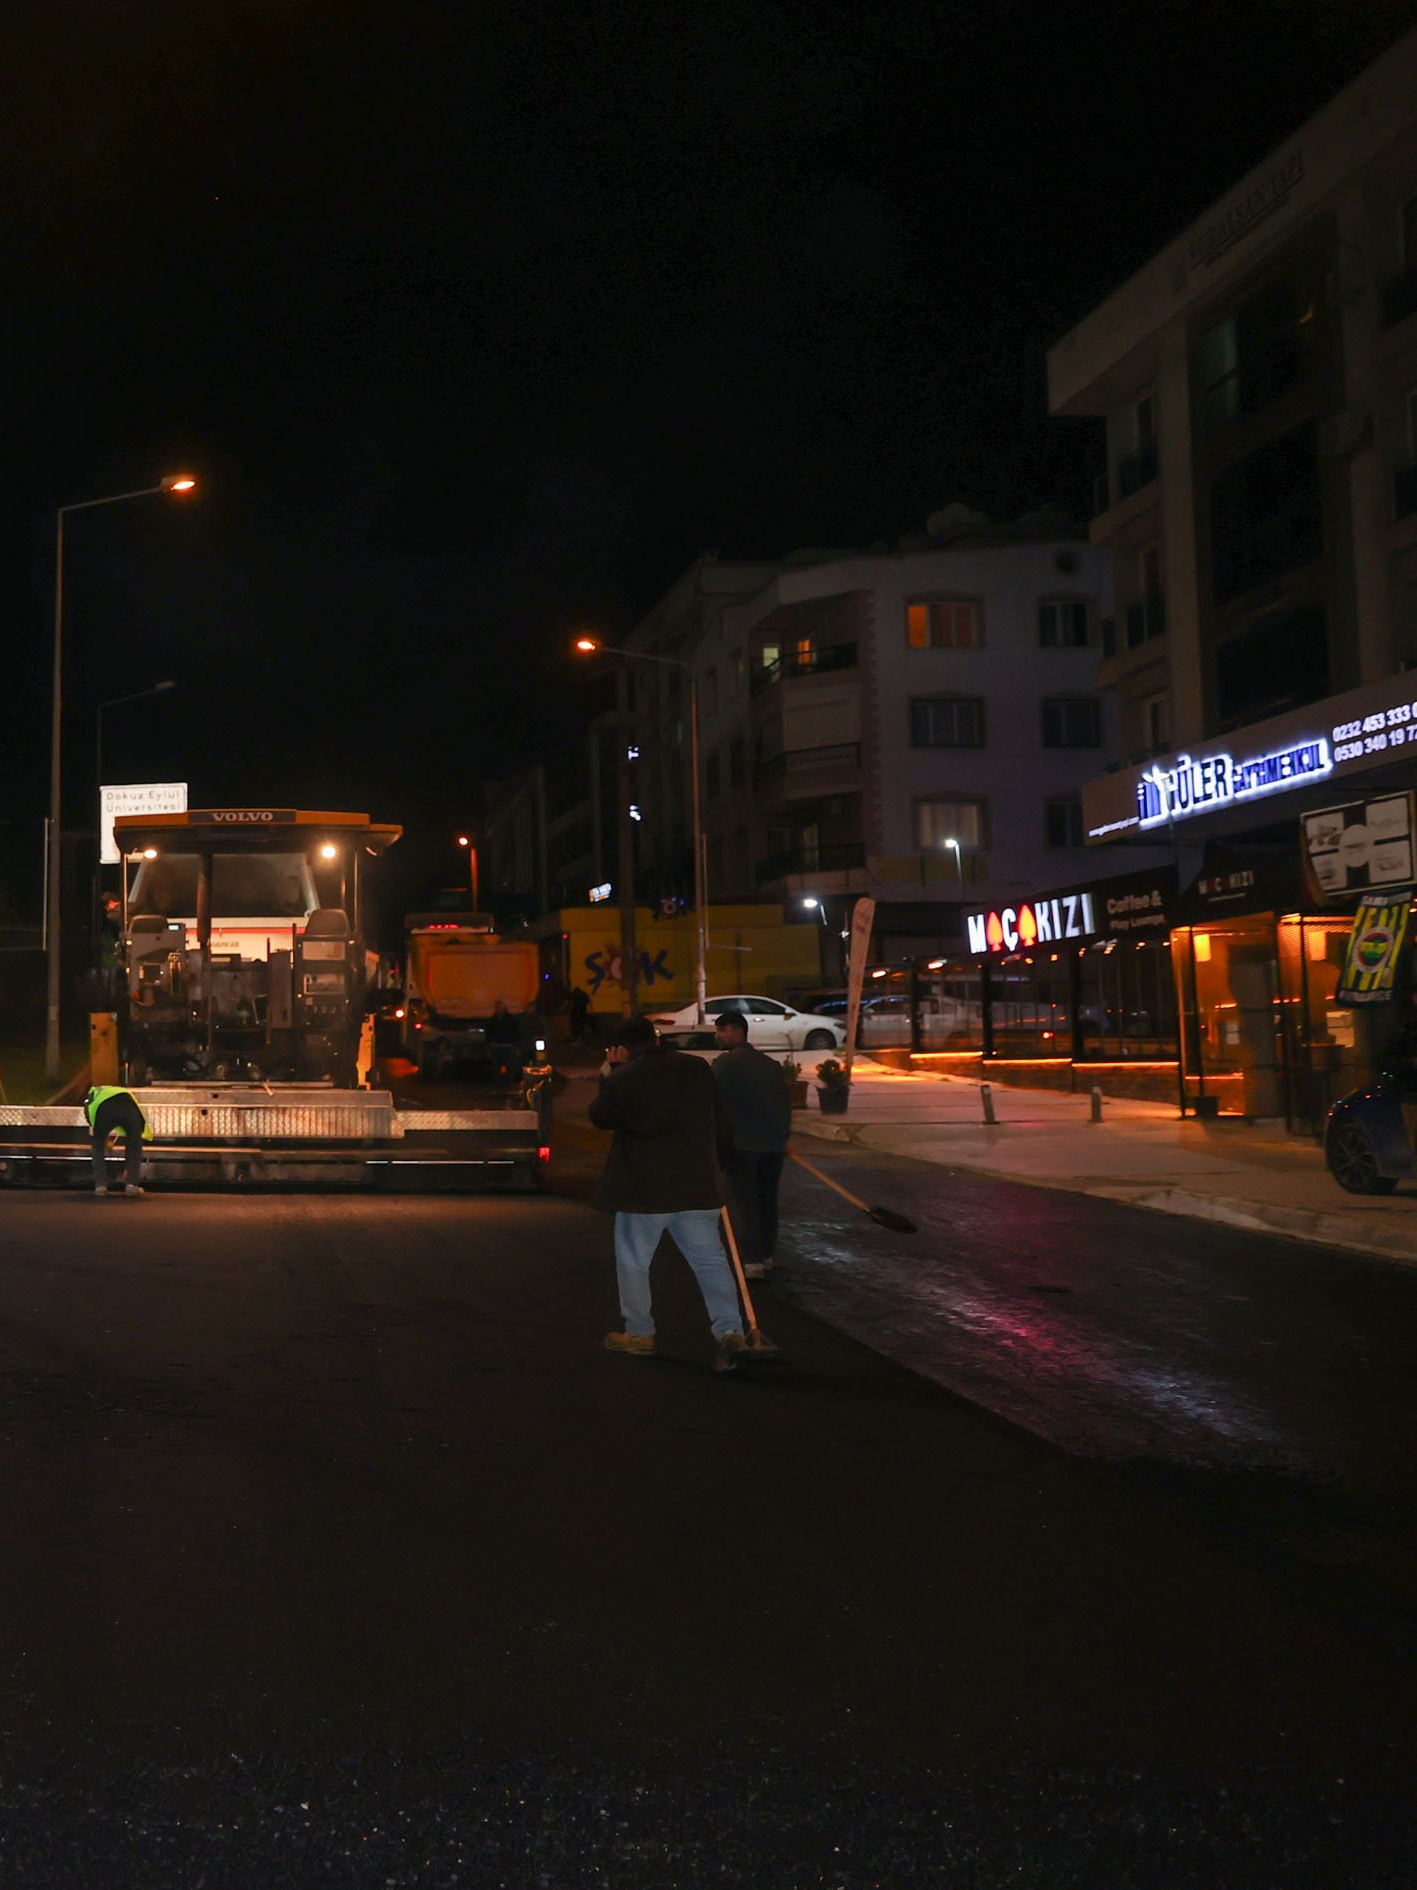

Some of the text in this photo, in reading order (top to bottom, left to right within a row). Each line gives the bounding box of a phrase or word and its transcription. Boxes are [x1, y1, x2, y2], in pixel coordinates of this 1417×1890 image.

[1332, 719, 1362, 742] 0232
[1386, 703, 1411, 726] 333
[1333, 740, 1363, 762] 0530
[1364, 733, 1388, 754] 340
[1388, 727, 1405, 747] 19
[106, 791, 143, 801] Dokuz
[212, 811, 274, 822] VOLVO
